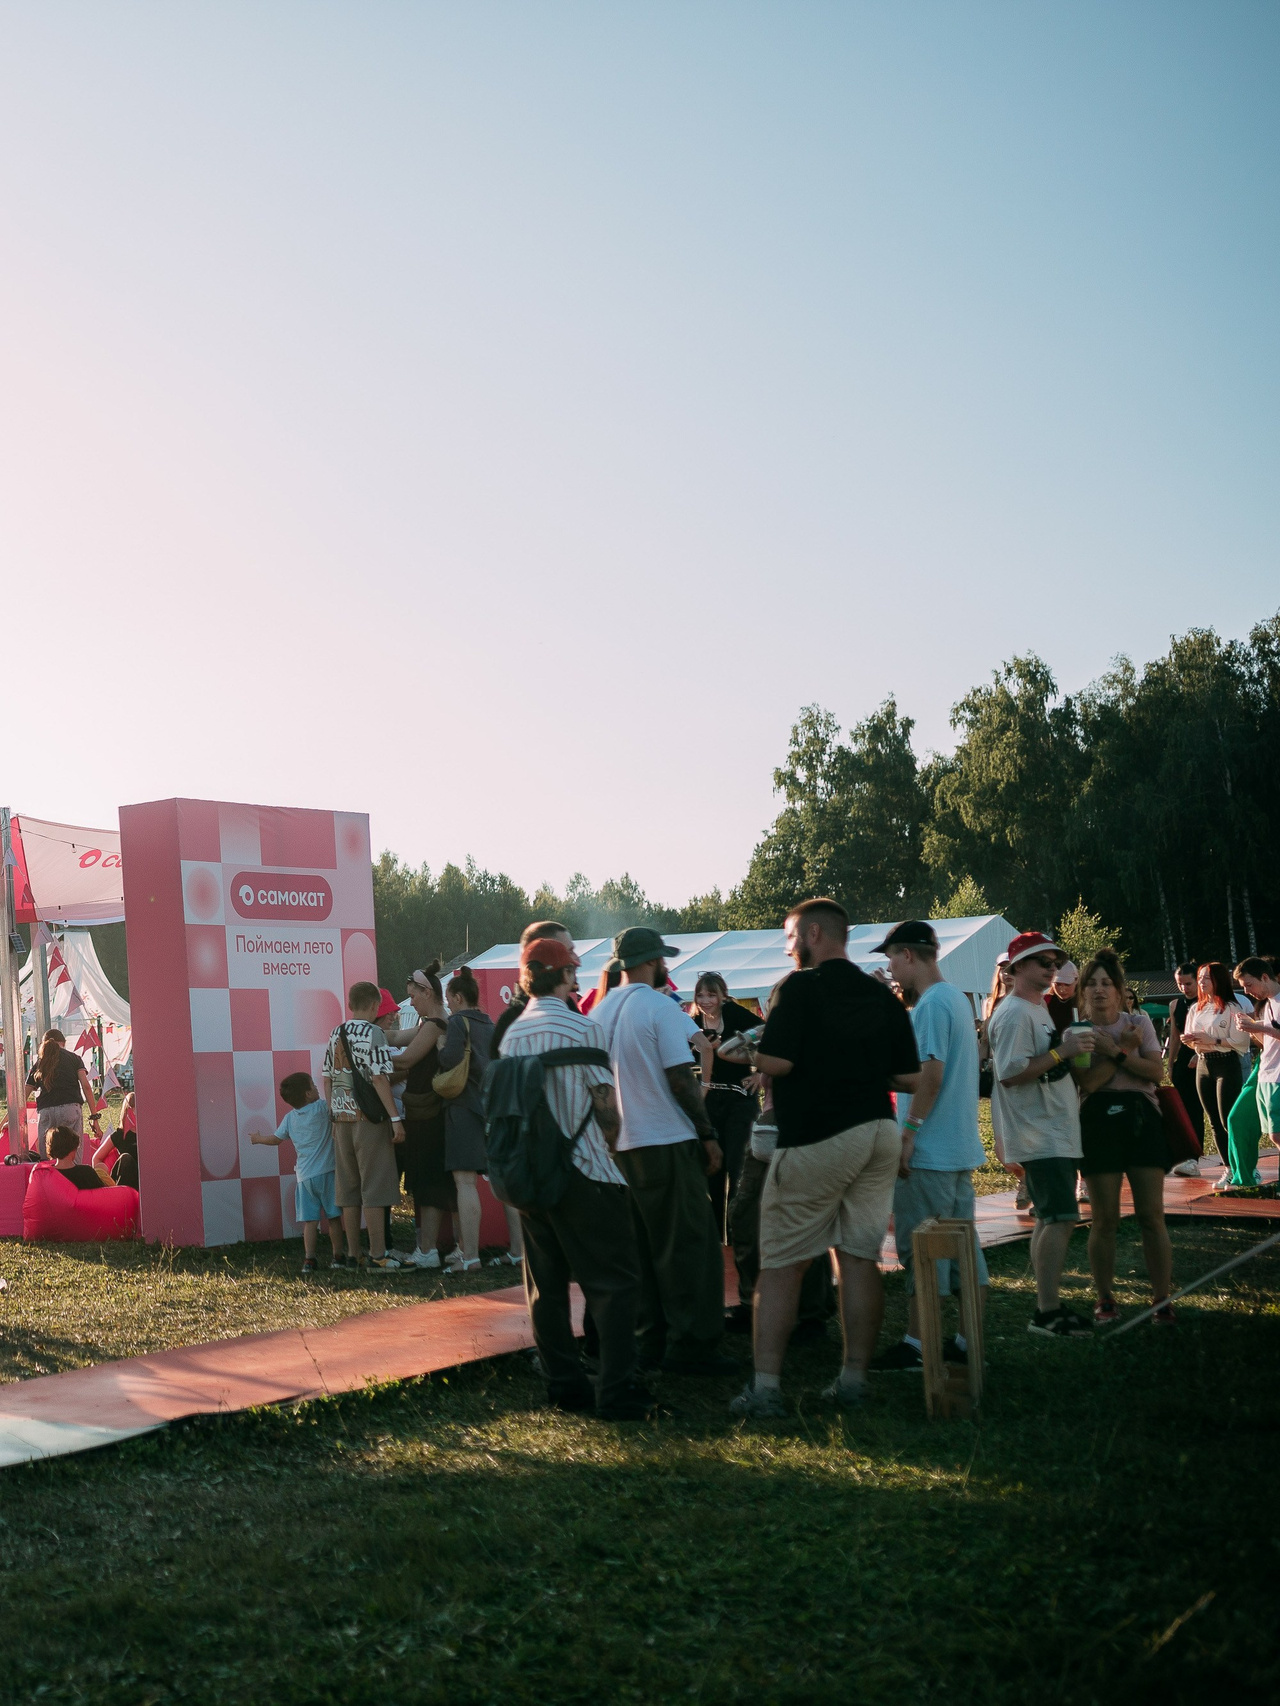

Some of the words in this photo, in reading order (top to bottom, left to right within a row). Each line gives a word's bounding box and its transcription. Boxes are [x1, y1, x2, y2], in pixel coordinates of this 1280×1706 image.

[257, 888, 326, 907] самокат
[235, 934, 301, 954] Поймаем
[303, 941, 334, 955] лето
[262, 962, 312, 976] вместе
